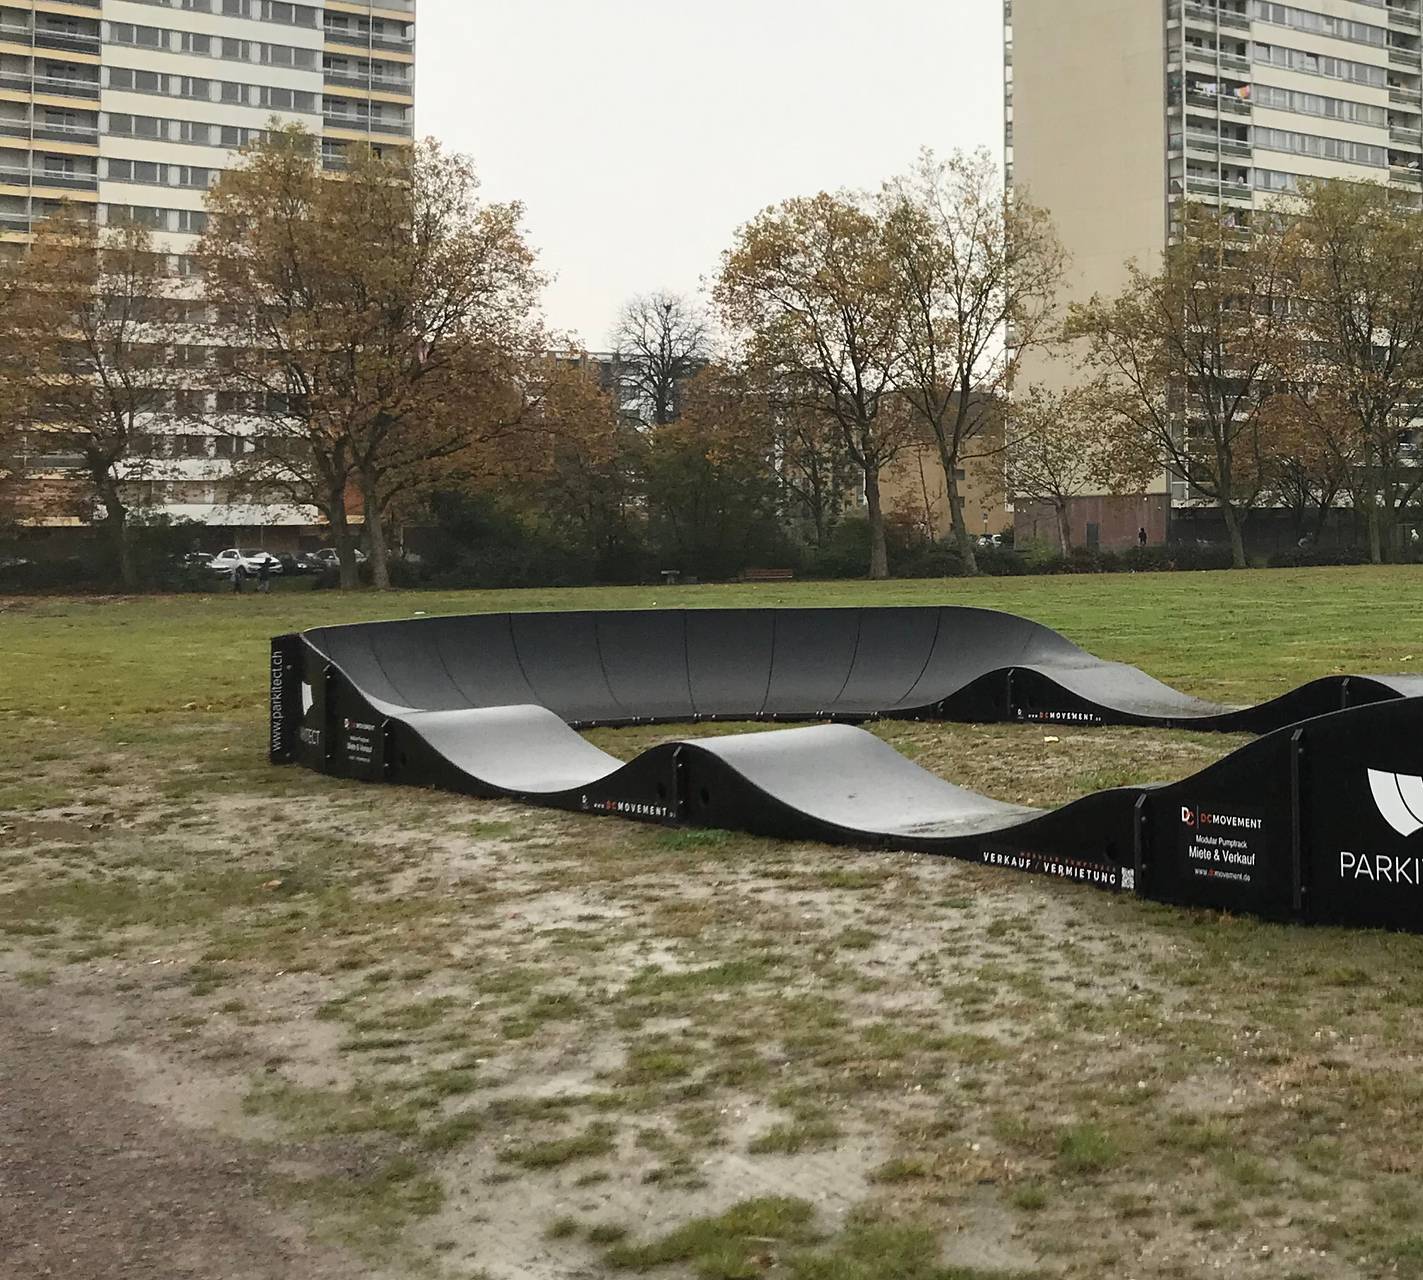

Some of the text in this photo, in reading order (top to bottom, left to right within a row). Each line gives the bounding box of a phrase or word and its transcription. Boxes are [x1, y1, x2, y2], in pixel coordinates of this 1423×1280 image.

[271, 650, 284, 752] www.parkitect.ch
[606, 800, 667, 817] DCMOVEMENT
[1200, 813, 1262, 829] DCMOVEMENT
[1195, 834, 1248, 849] Modular Pumptrack
[1189, 845, 1256, 866] Miete & Verkauf
[983, 851, 1032, 869] VERKAUF
[1043, 862, 1116, 884] VERMIETUNG
